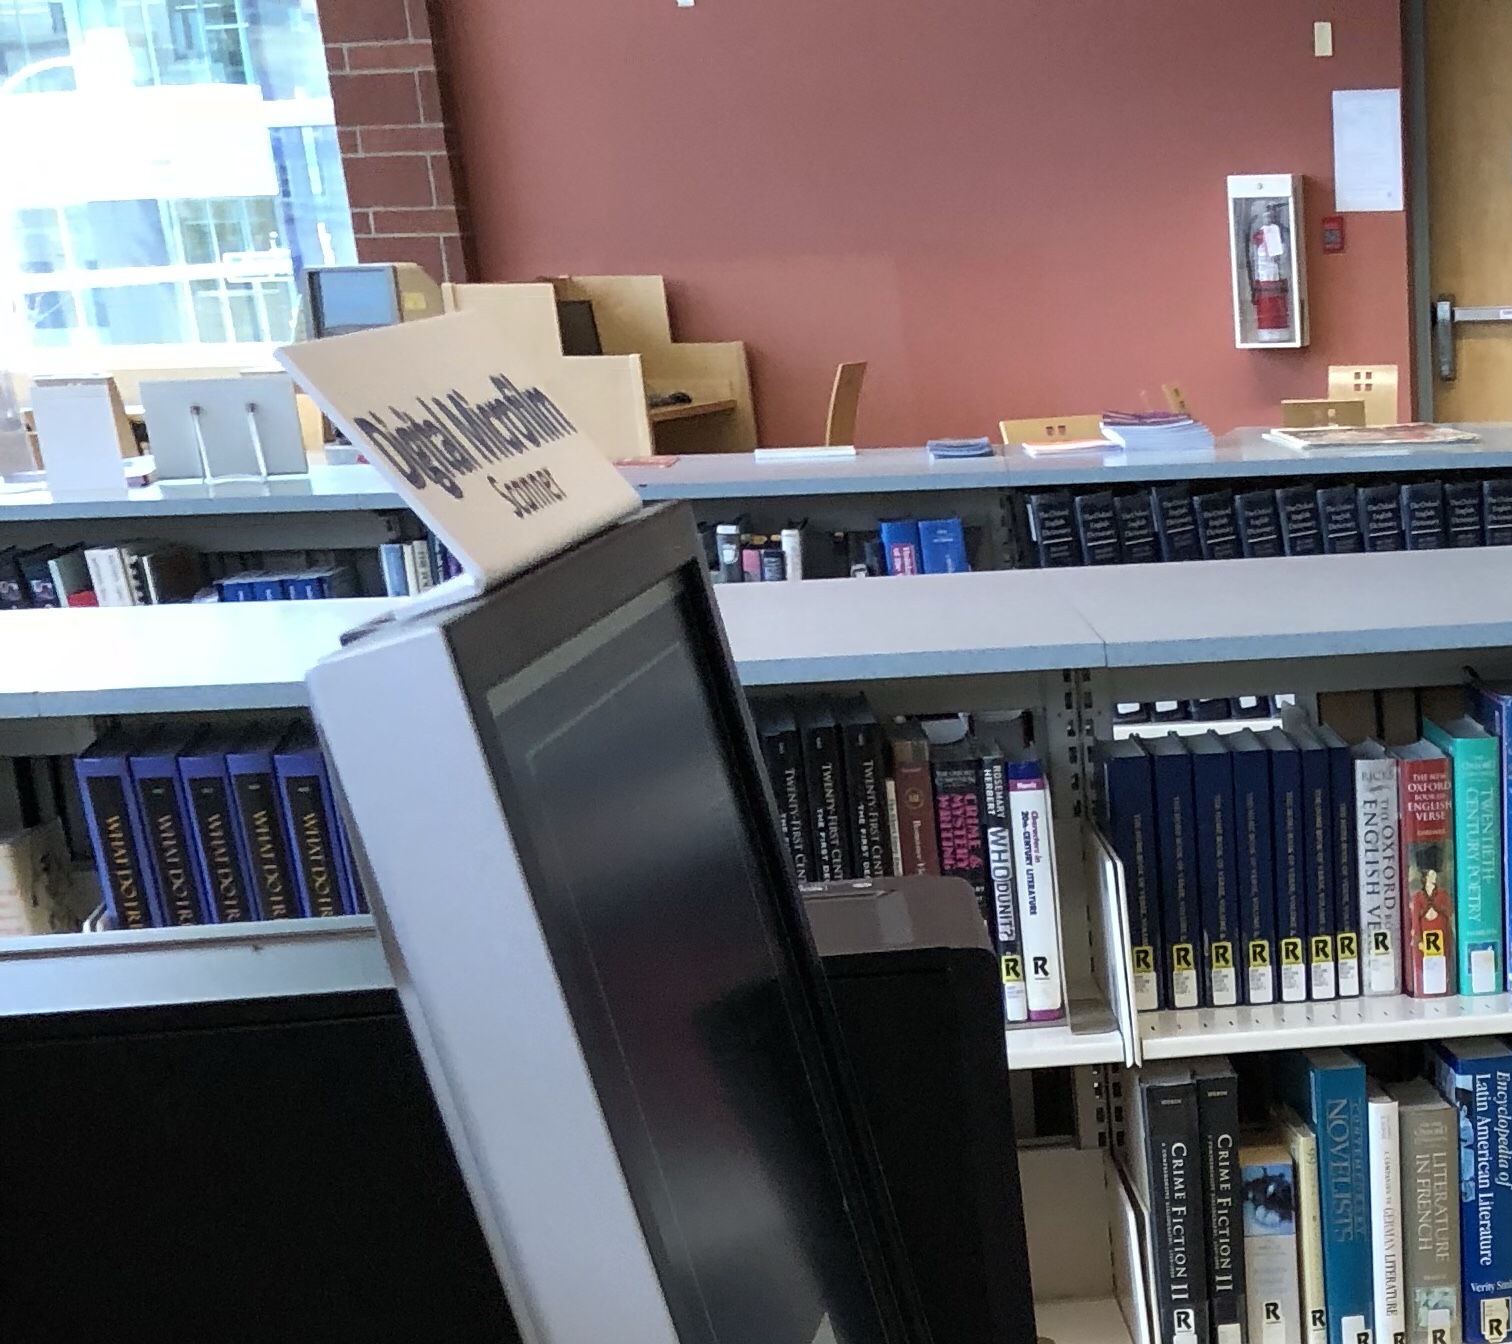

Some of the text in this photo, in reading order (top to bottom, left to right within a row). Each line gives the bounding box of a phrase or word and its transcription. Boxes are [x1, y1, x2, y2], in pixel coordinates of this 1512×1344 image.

[354, 373, 578, 499] Digital Microfilm
[487, 467, 568, 519] Scanner
[984, 769, 996, 815] HERBERT
[1408, 783, 1451, 792] OXFORD
[1408, 801, 1452, 811] ENGLISH
[1416, 811, 1446, 821] VERSE
[1363, 800, 1381, 896] ENGLISH
[1382, 826, 1395, 910] OXFORD
[1466, 789, 1482, 922] CENTURY POETRY
[1481, 789, 1496, 884] TWENTIETH
[1034, 957, 1049, 977] R
[1426, 932, 1441, 951] R
[1327, 1100, 1355, 1243] NOVELISTS
[1475, 1073, 1492, 1265] Latin American Literature
[1495, 1072, 1512, 1189] Encyclopedia of
[1171, 1142, 1188, 1300] CRIME FICTION II
[1416, 1177, 1432, 1251] FRENCH
[1430, 1152, 1449, 1262] LITERATURE
[1177, 1311, 1190, 1329] R
